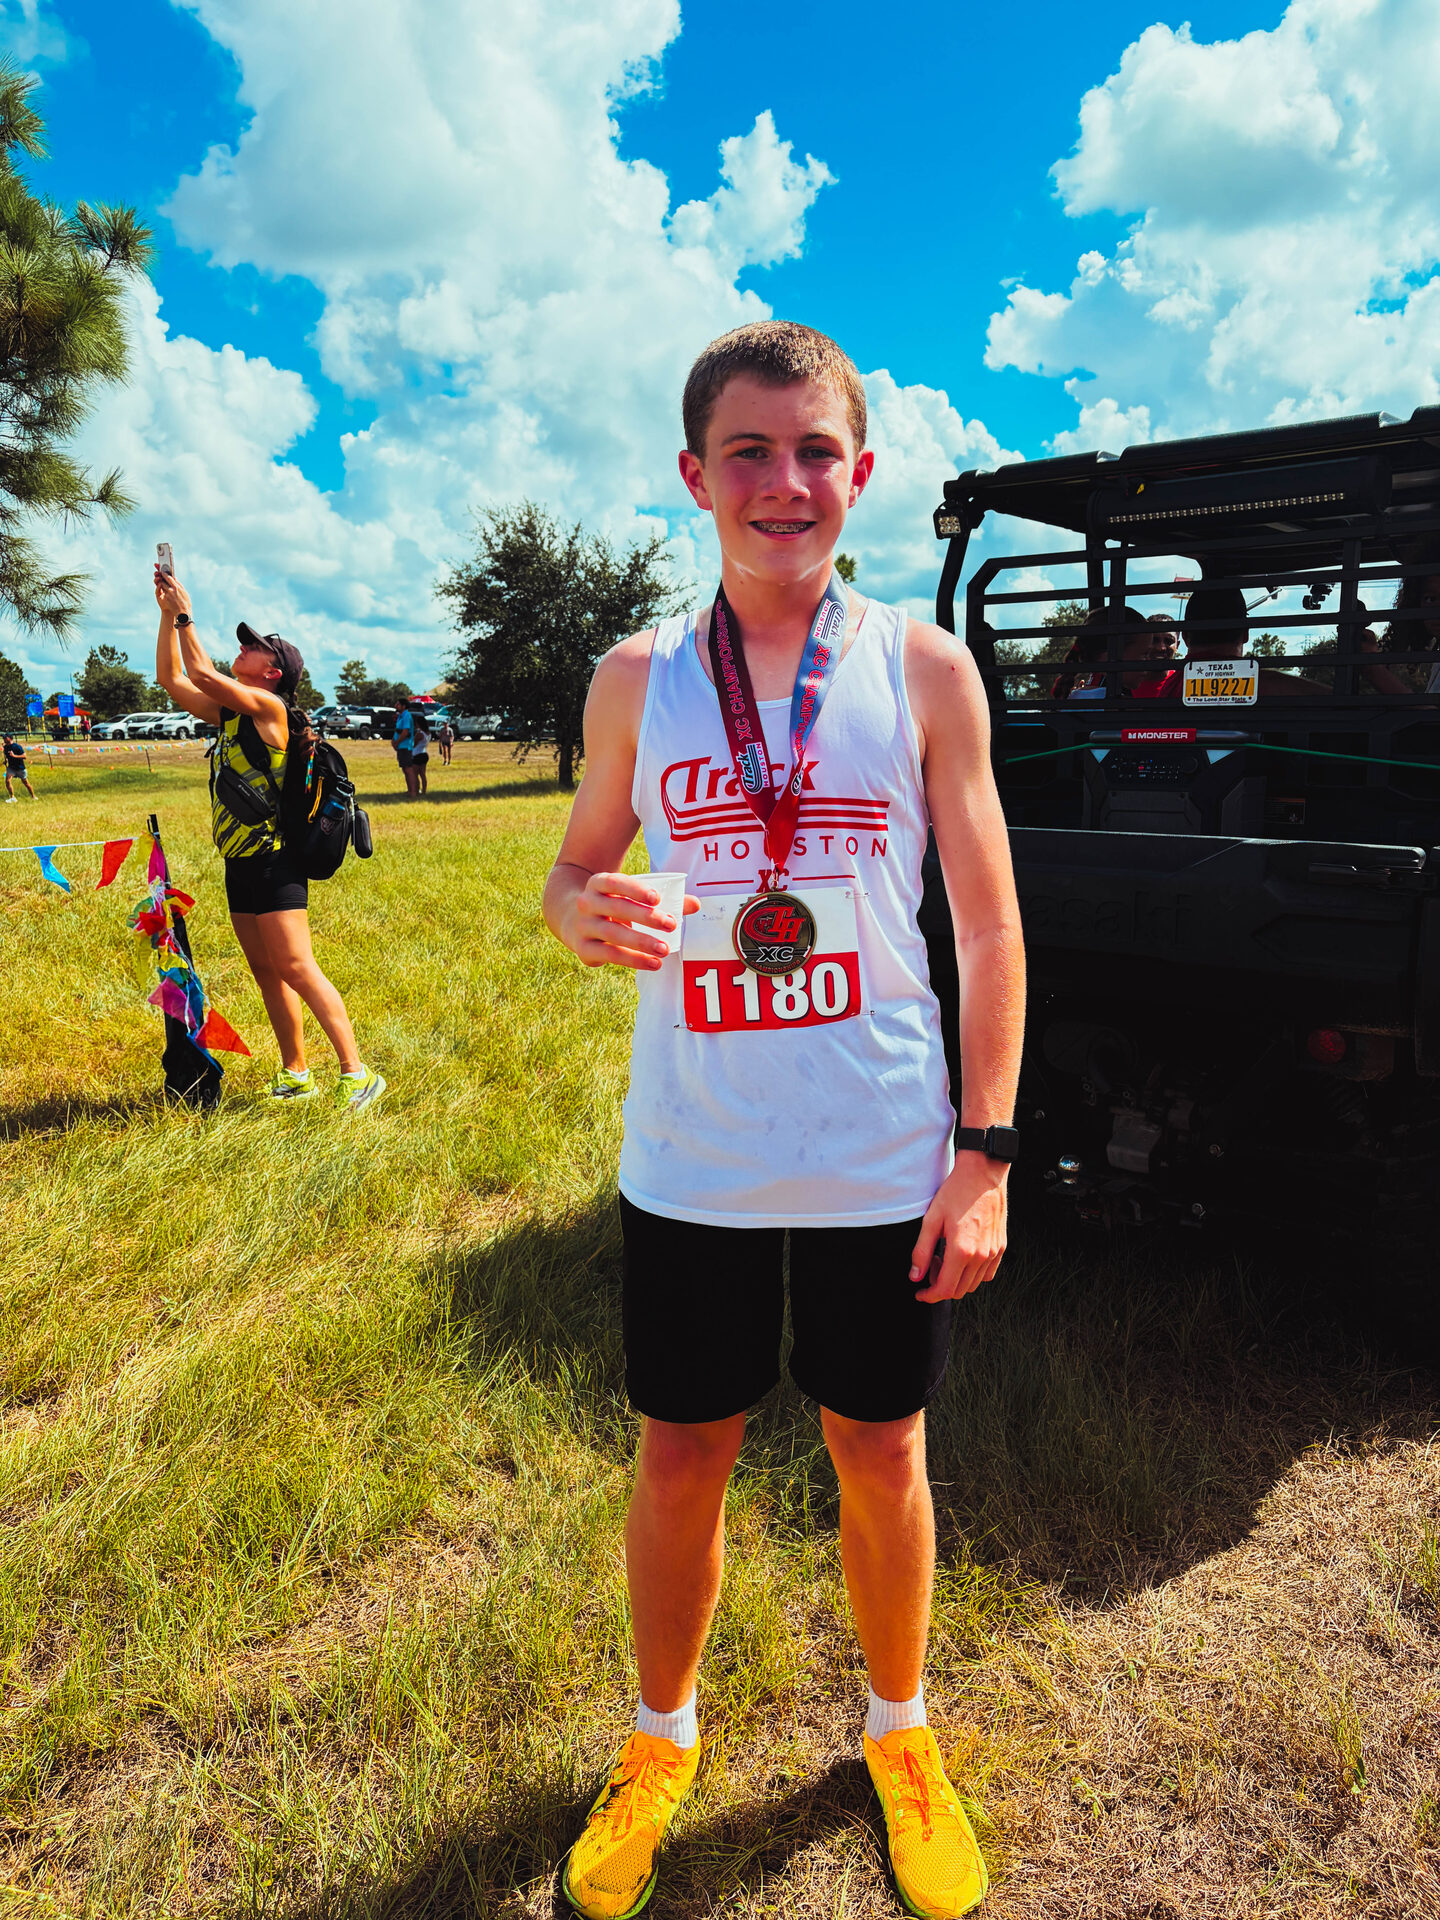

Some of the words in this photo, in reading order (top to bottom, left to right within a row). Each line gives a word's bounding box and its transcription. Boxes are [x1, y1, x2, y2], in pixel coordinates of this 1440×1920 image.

[814, 600, 831, 638] HOUSTON
[830, 606, 845, 638] Track
[812, 643, 831, 667] XC
[1190, 678, 1250, 697] 1L9227
[735, 717, 753, 740] XC
[1137, 731, 1189, 740] MONSTER
[737, 752, 757, 793] Track
[756, 743, 769, 787] HOUSTON
[704, 835, 888, 862] HOSTON
[756, 946, 794, 963] XC
[695, 961, 849, 1023] 1180
